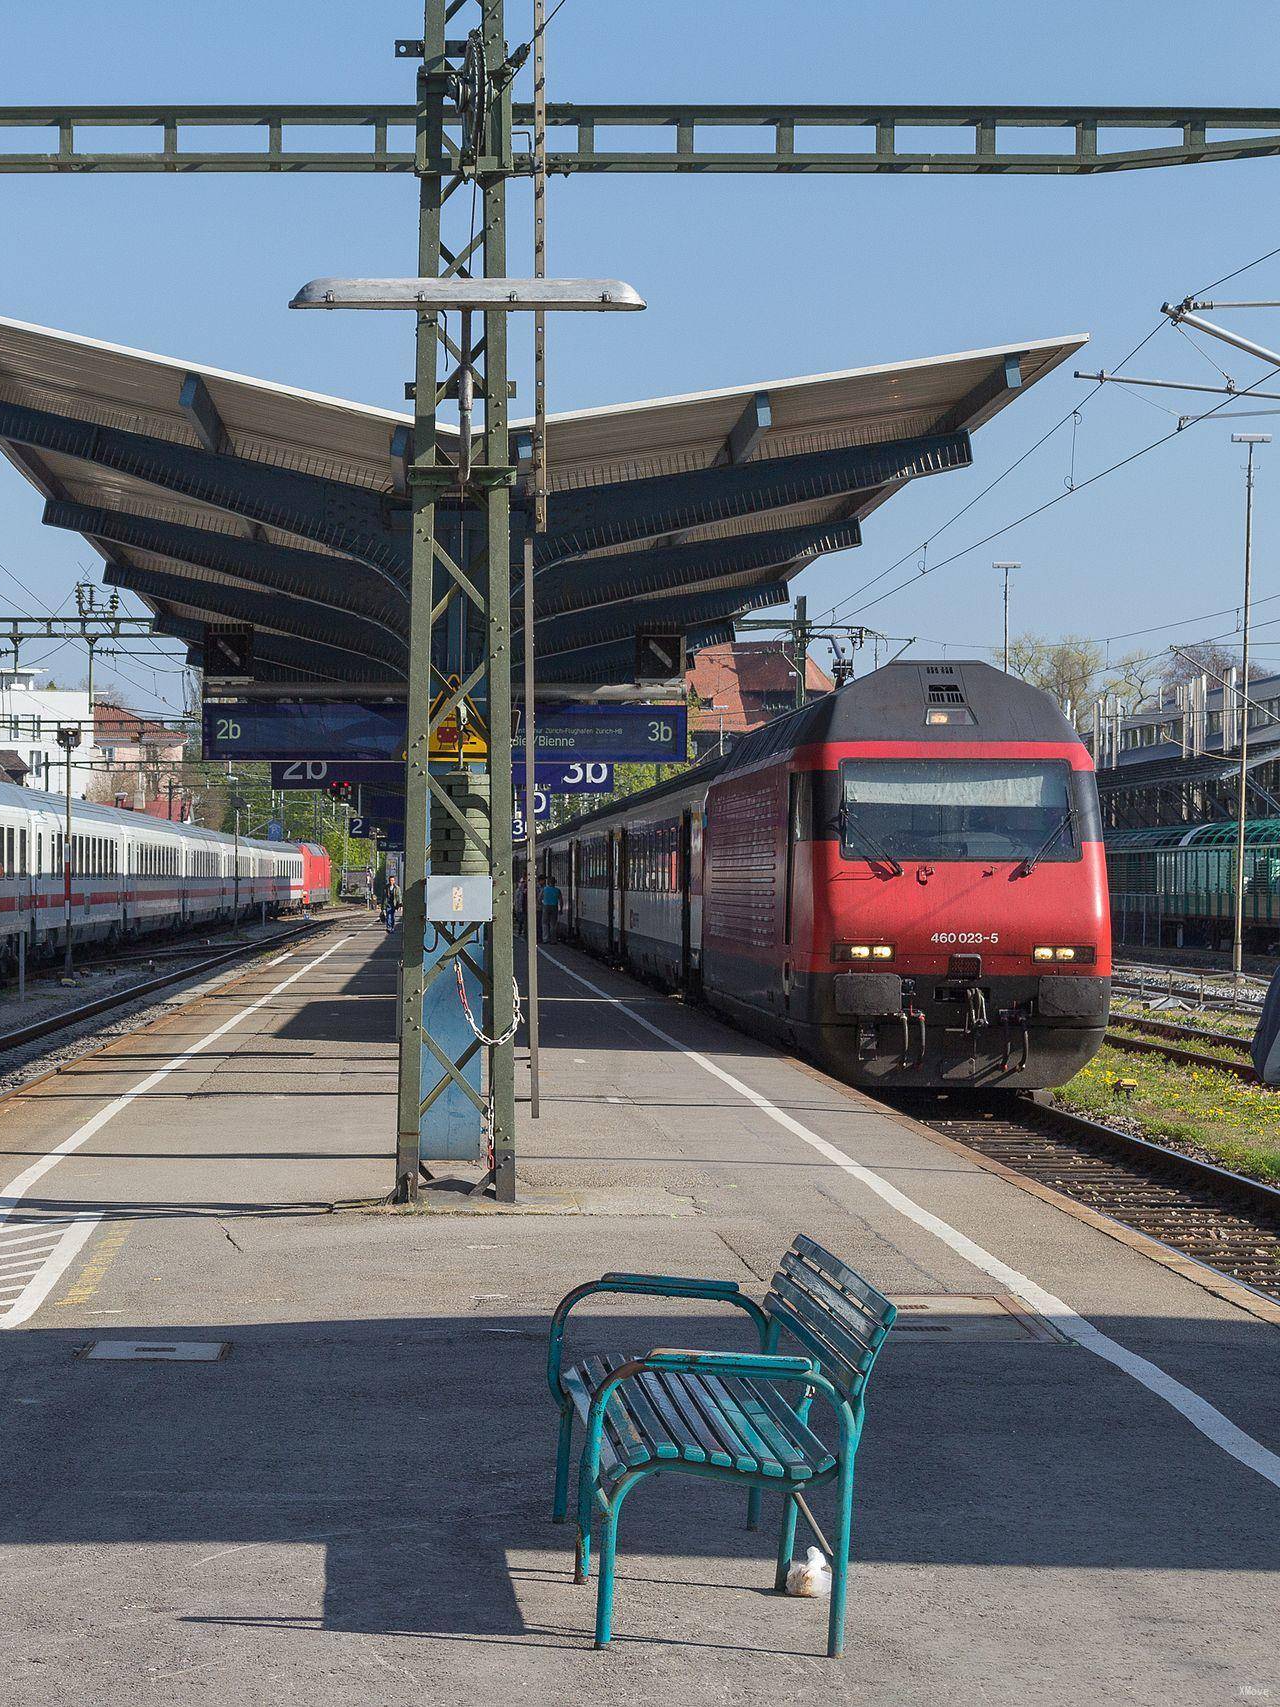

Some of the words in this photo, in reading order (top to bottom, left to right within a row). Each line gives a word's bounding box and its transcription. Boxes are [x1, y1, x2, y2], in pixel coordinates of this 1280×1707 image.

[216, 719, 241, 740] 2b
[647, 721, 673, 742] 3b
[512, 735, 575, 747] Bie/Bienne
[351, 818, 363, 834] 2
[930, 932, 956, 944] 460
[958, 932, 999, 944] 023-5
